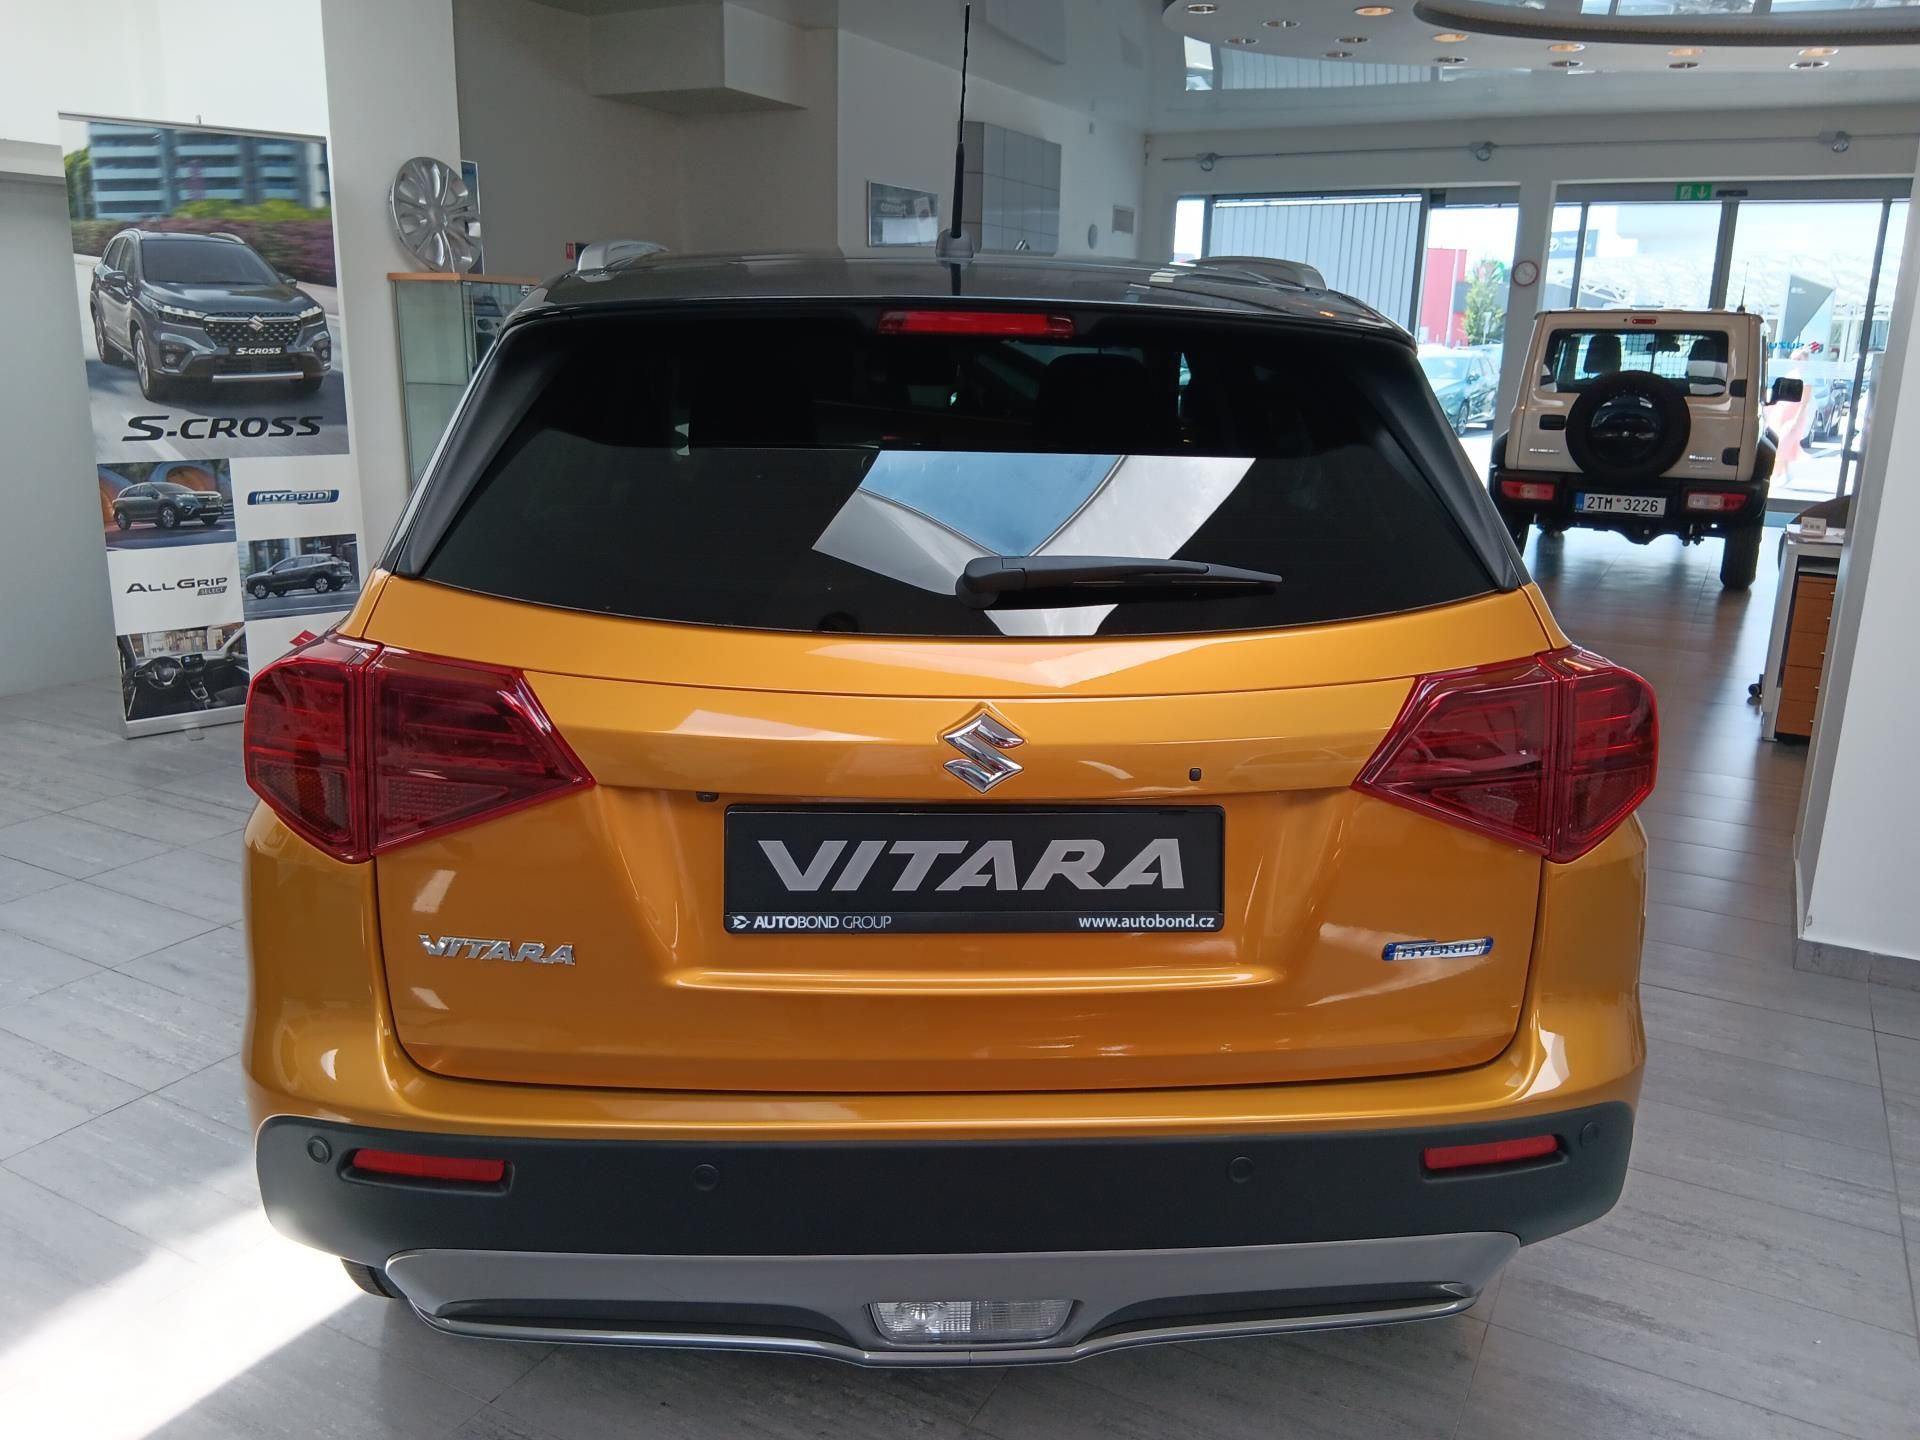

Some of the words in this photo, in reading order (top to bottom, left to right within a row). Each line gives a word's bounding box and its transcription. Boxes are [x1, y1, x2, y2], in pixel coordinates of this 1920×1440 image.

[235, 347, 281, 355] S-CROSS
[121, 415, 323, 441] S-CROSS
[261, 492, 327, 502] HYBRID
[1587, 496, 1613, 510] 2TM
[1623, 498, 1659, 512] 3226
[200, 586, 227, 595] SELECT
[757, 838, 1185, 892] VITARA
[753, 915, 839, 929] AUTOBOND
[843, 915, 892, 929] GROUP
[1078, 914, 1215, 928] www.autobond.cz
[418, 934, 576, 966] VITARA
[1400, 942, 1479, 958] HYBRID
